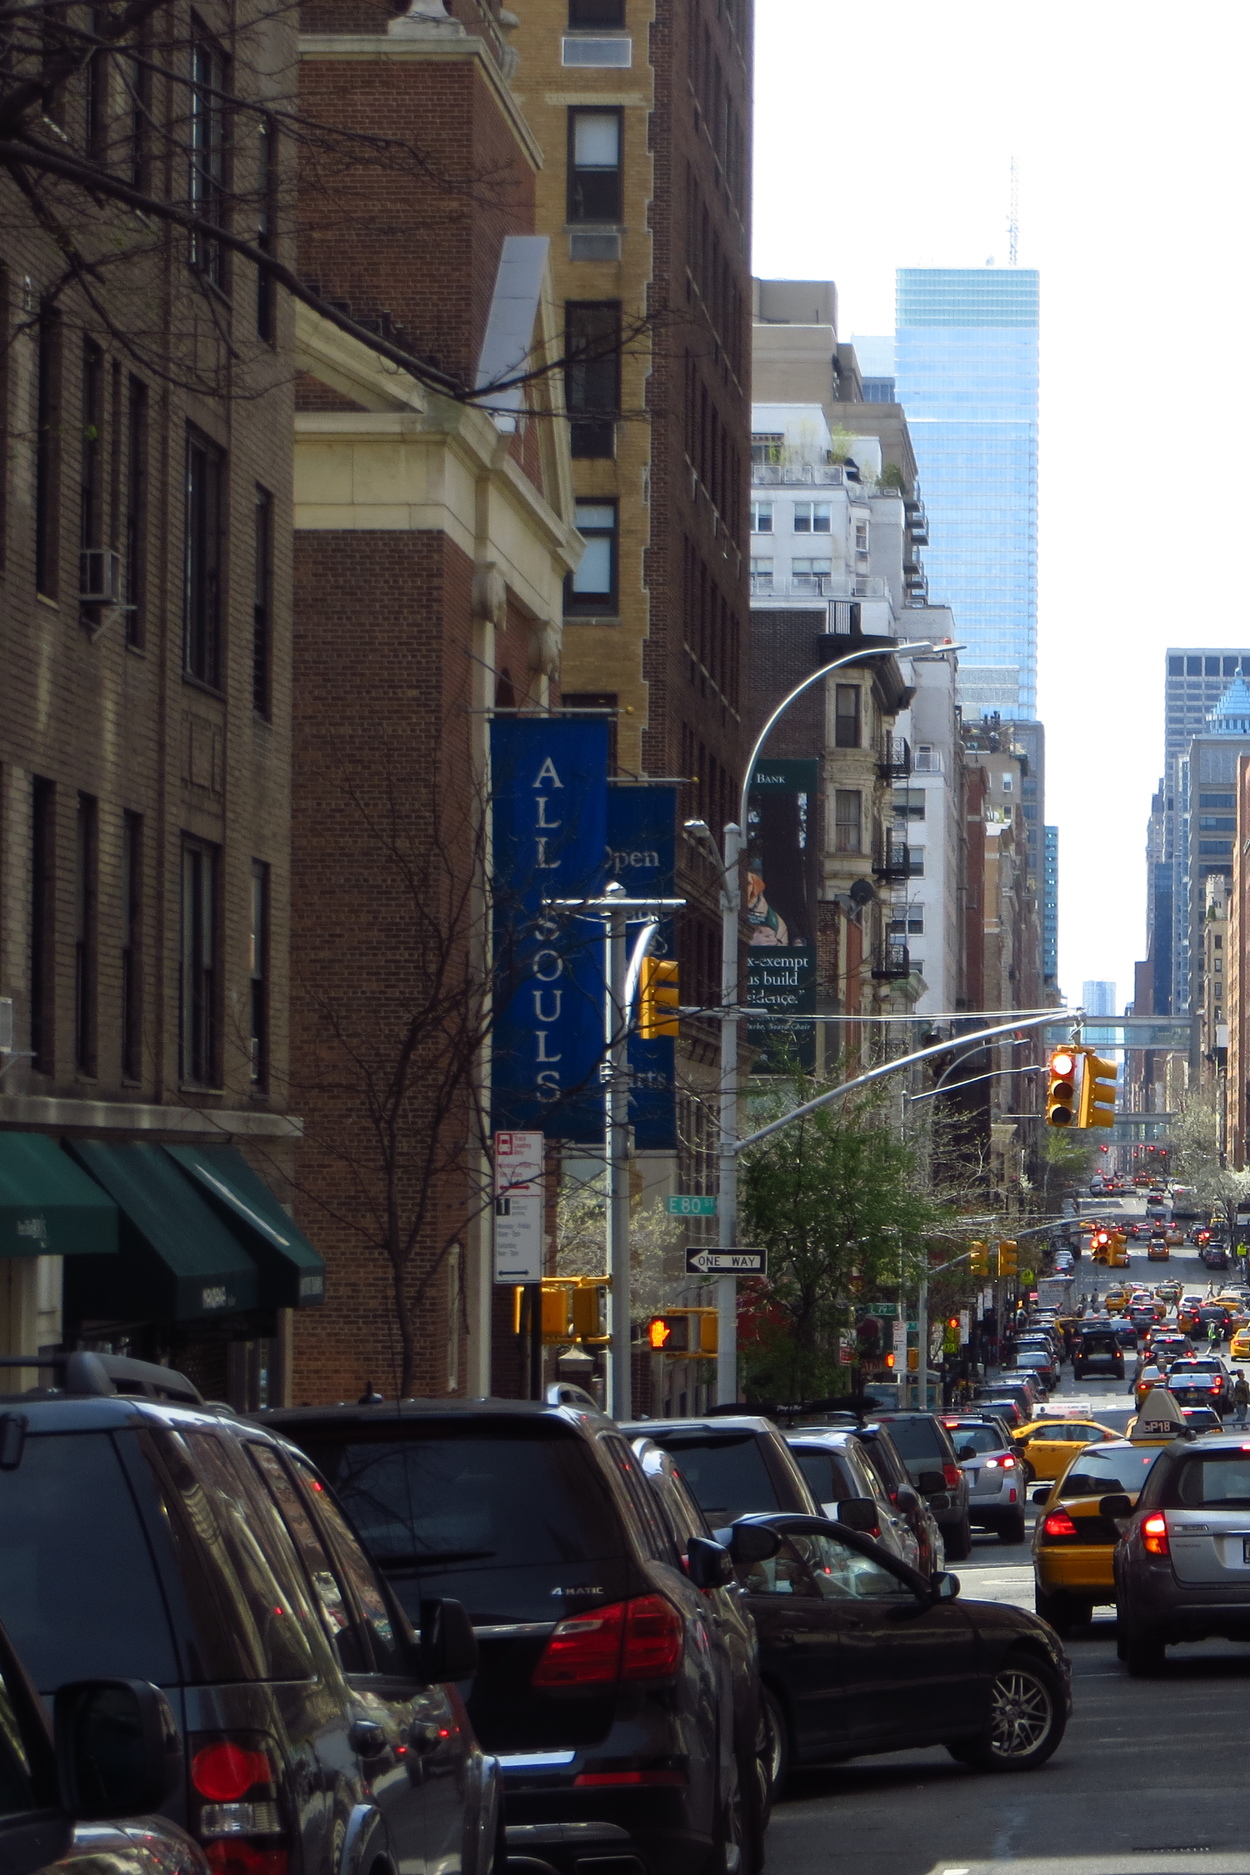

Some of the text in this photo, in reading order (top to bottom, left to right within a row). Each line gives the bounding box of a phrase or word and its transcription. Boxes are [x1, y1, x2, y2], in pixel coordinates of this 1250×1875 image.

[532, 756, 564, 868] ALL
[605, 846, 660, 873] pen
[763, 971, 798, 985] build
[532, 911, 564, 1101] SOULS
[669, 1198, 714, 1213] E 80 ST
[698, 1256, 756, 1266] ONE WAY
